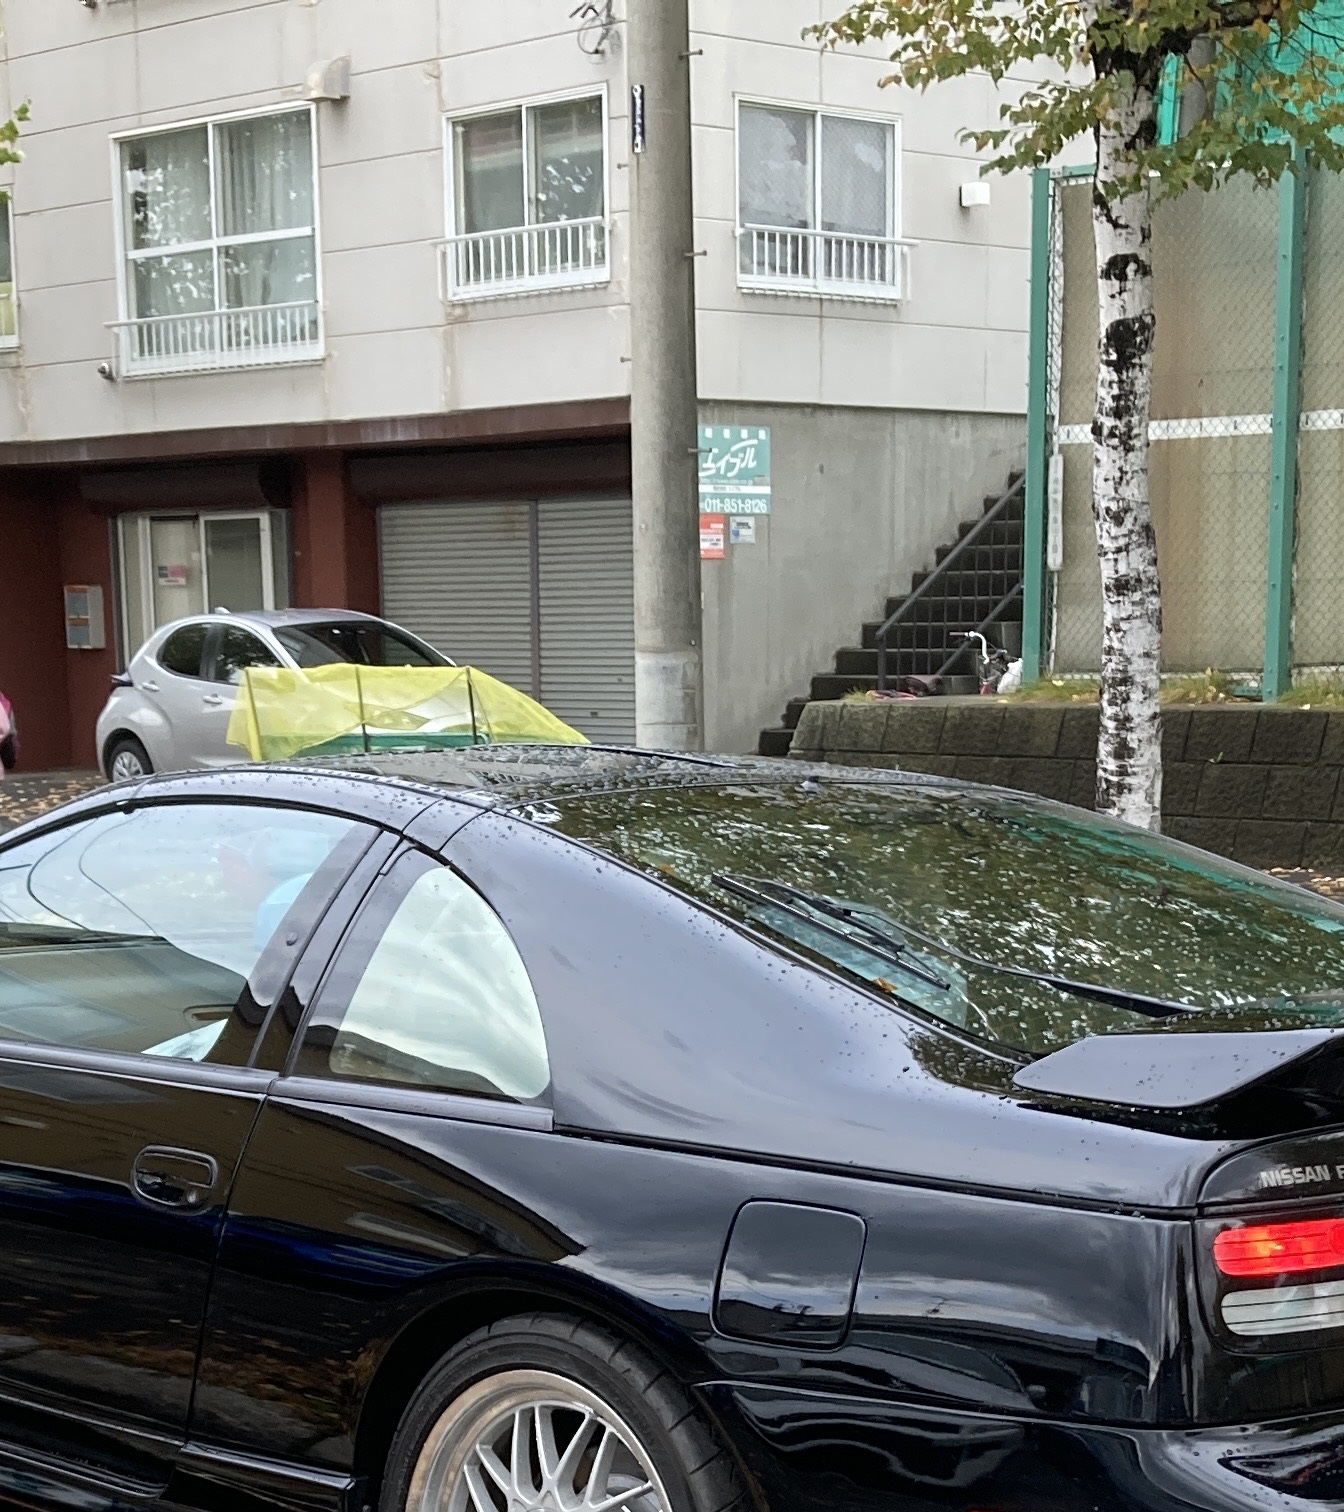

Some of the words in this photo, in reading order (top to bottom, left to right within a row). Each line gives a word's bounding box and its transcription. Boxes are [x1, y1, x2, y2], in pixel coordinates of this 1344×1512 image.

[699, 439, 758, 477] エイブル
[704, 498, 767, 513] 011-851-8126
[1259, 1164, 1331, 1188] NISSAN
